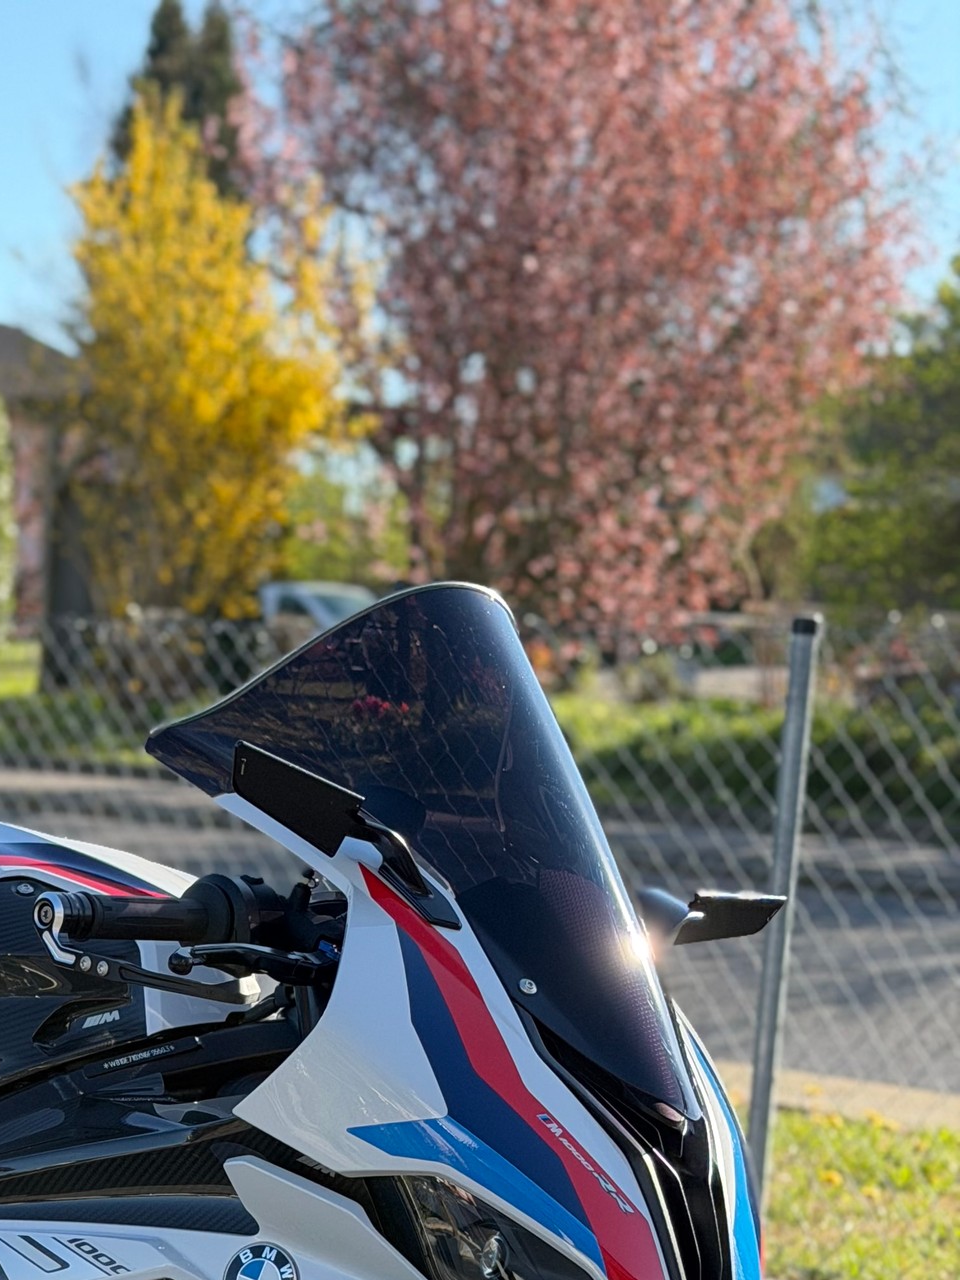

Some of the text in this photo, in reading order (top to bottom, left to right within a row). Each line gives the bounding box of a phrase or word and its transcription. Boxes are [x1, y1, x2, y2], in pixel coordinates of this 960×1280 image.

[559, 1137, 595, 1172] 1000
[592, 1171, 635, 1214] RR
[239, 1246, 294, 1279] BMW
